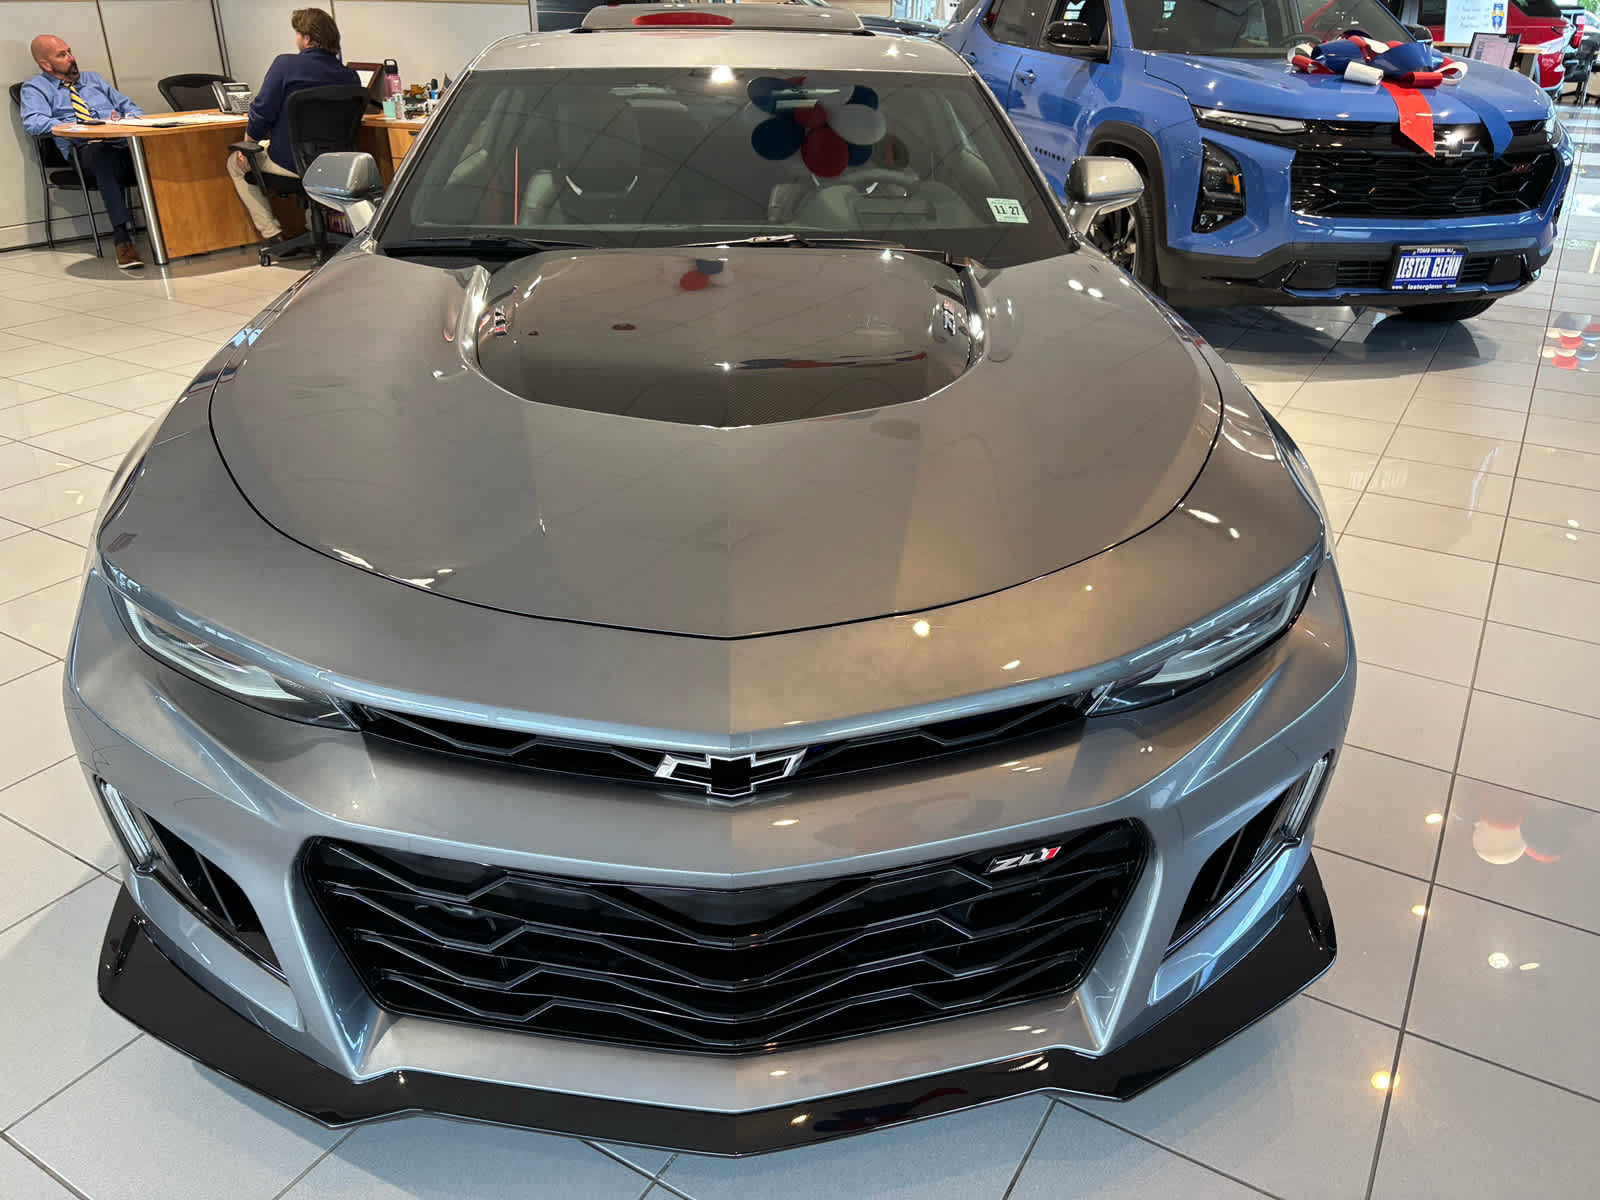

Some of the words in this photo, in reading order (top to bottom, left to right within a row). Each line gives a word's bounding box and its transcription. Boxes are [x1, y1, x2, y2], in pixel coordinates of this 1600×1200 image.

[993, 205, 1006, 215] 11
[1008, 206, 1020, 216] 27
[1396, 257, 1432, 278] LESTER
[1430, 256, 1463, 278] GLENN
[989, 846, 1061, 873] ZL1
